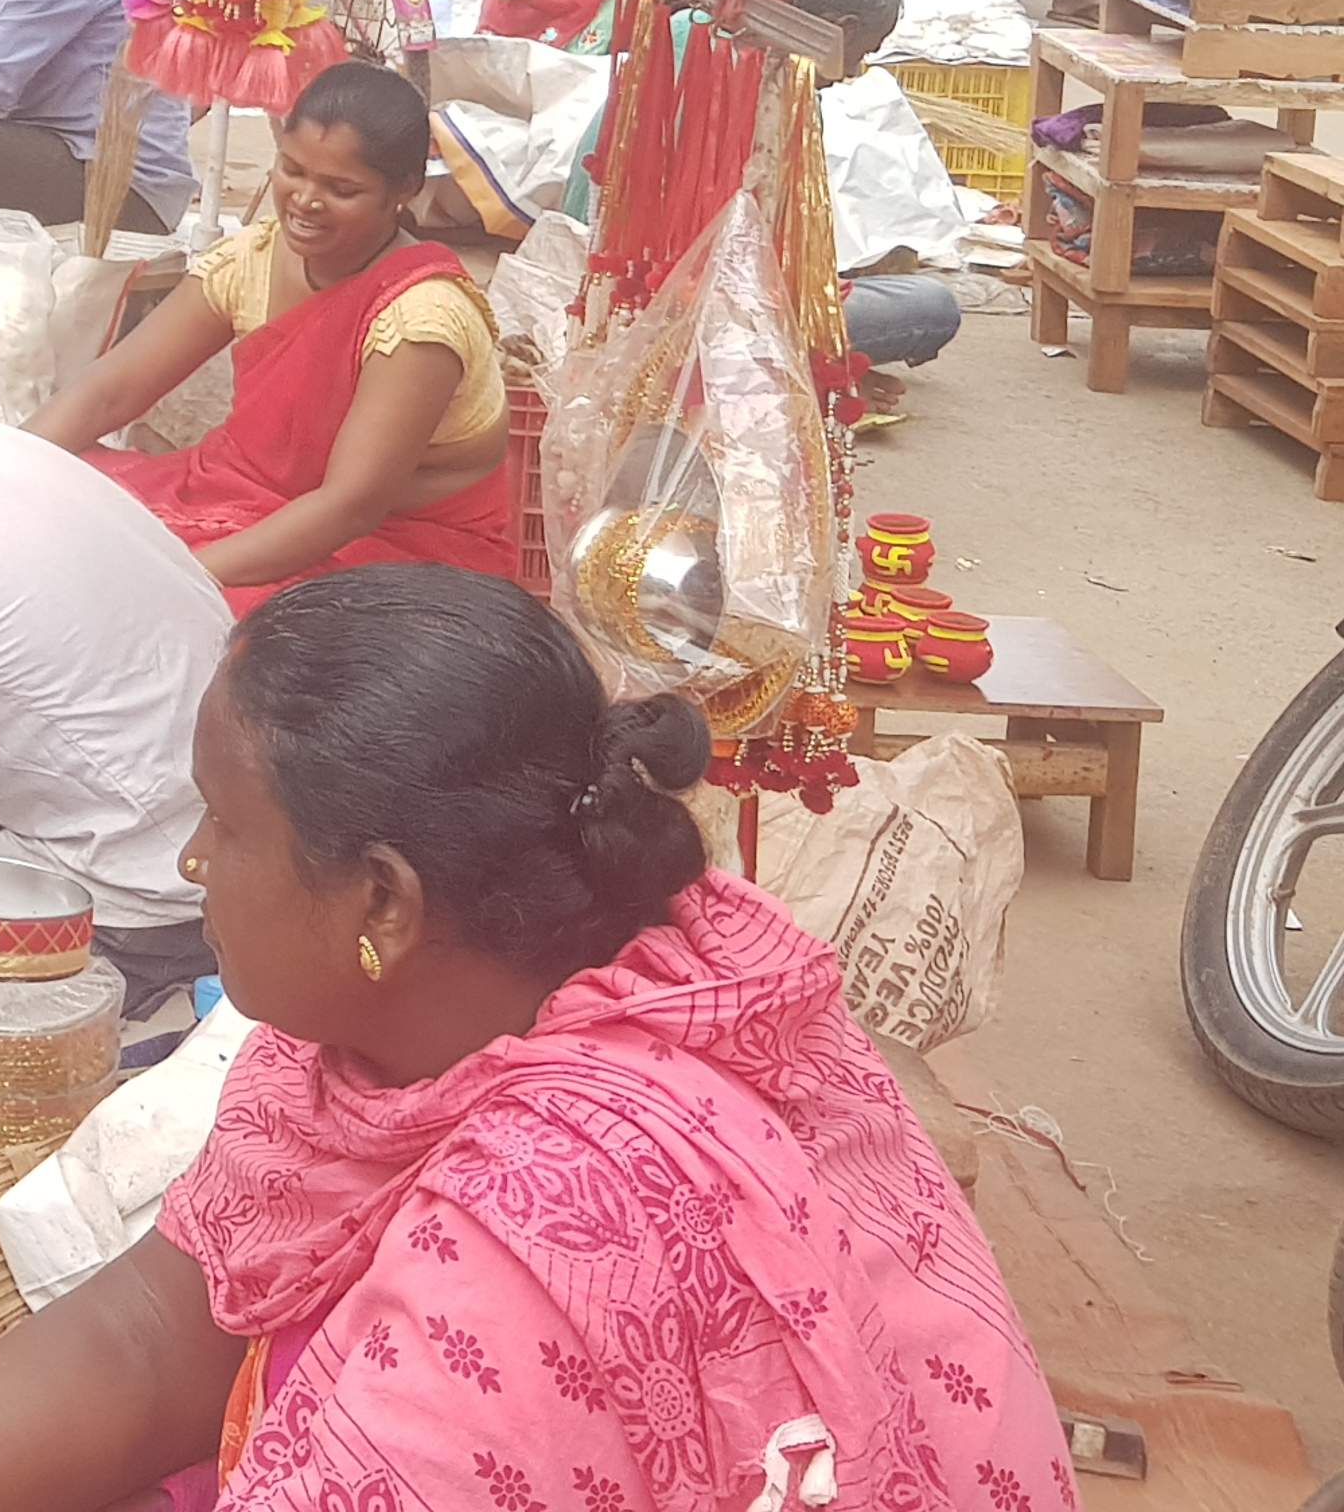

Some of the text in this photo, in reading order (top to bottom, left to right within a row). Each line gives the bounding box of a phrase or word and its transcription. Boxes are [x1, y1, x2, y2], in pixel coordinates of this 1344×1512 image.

[871, 849, 898, 902] BEFORE
[864, 894, 945, 1028] 100% VEG
